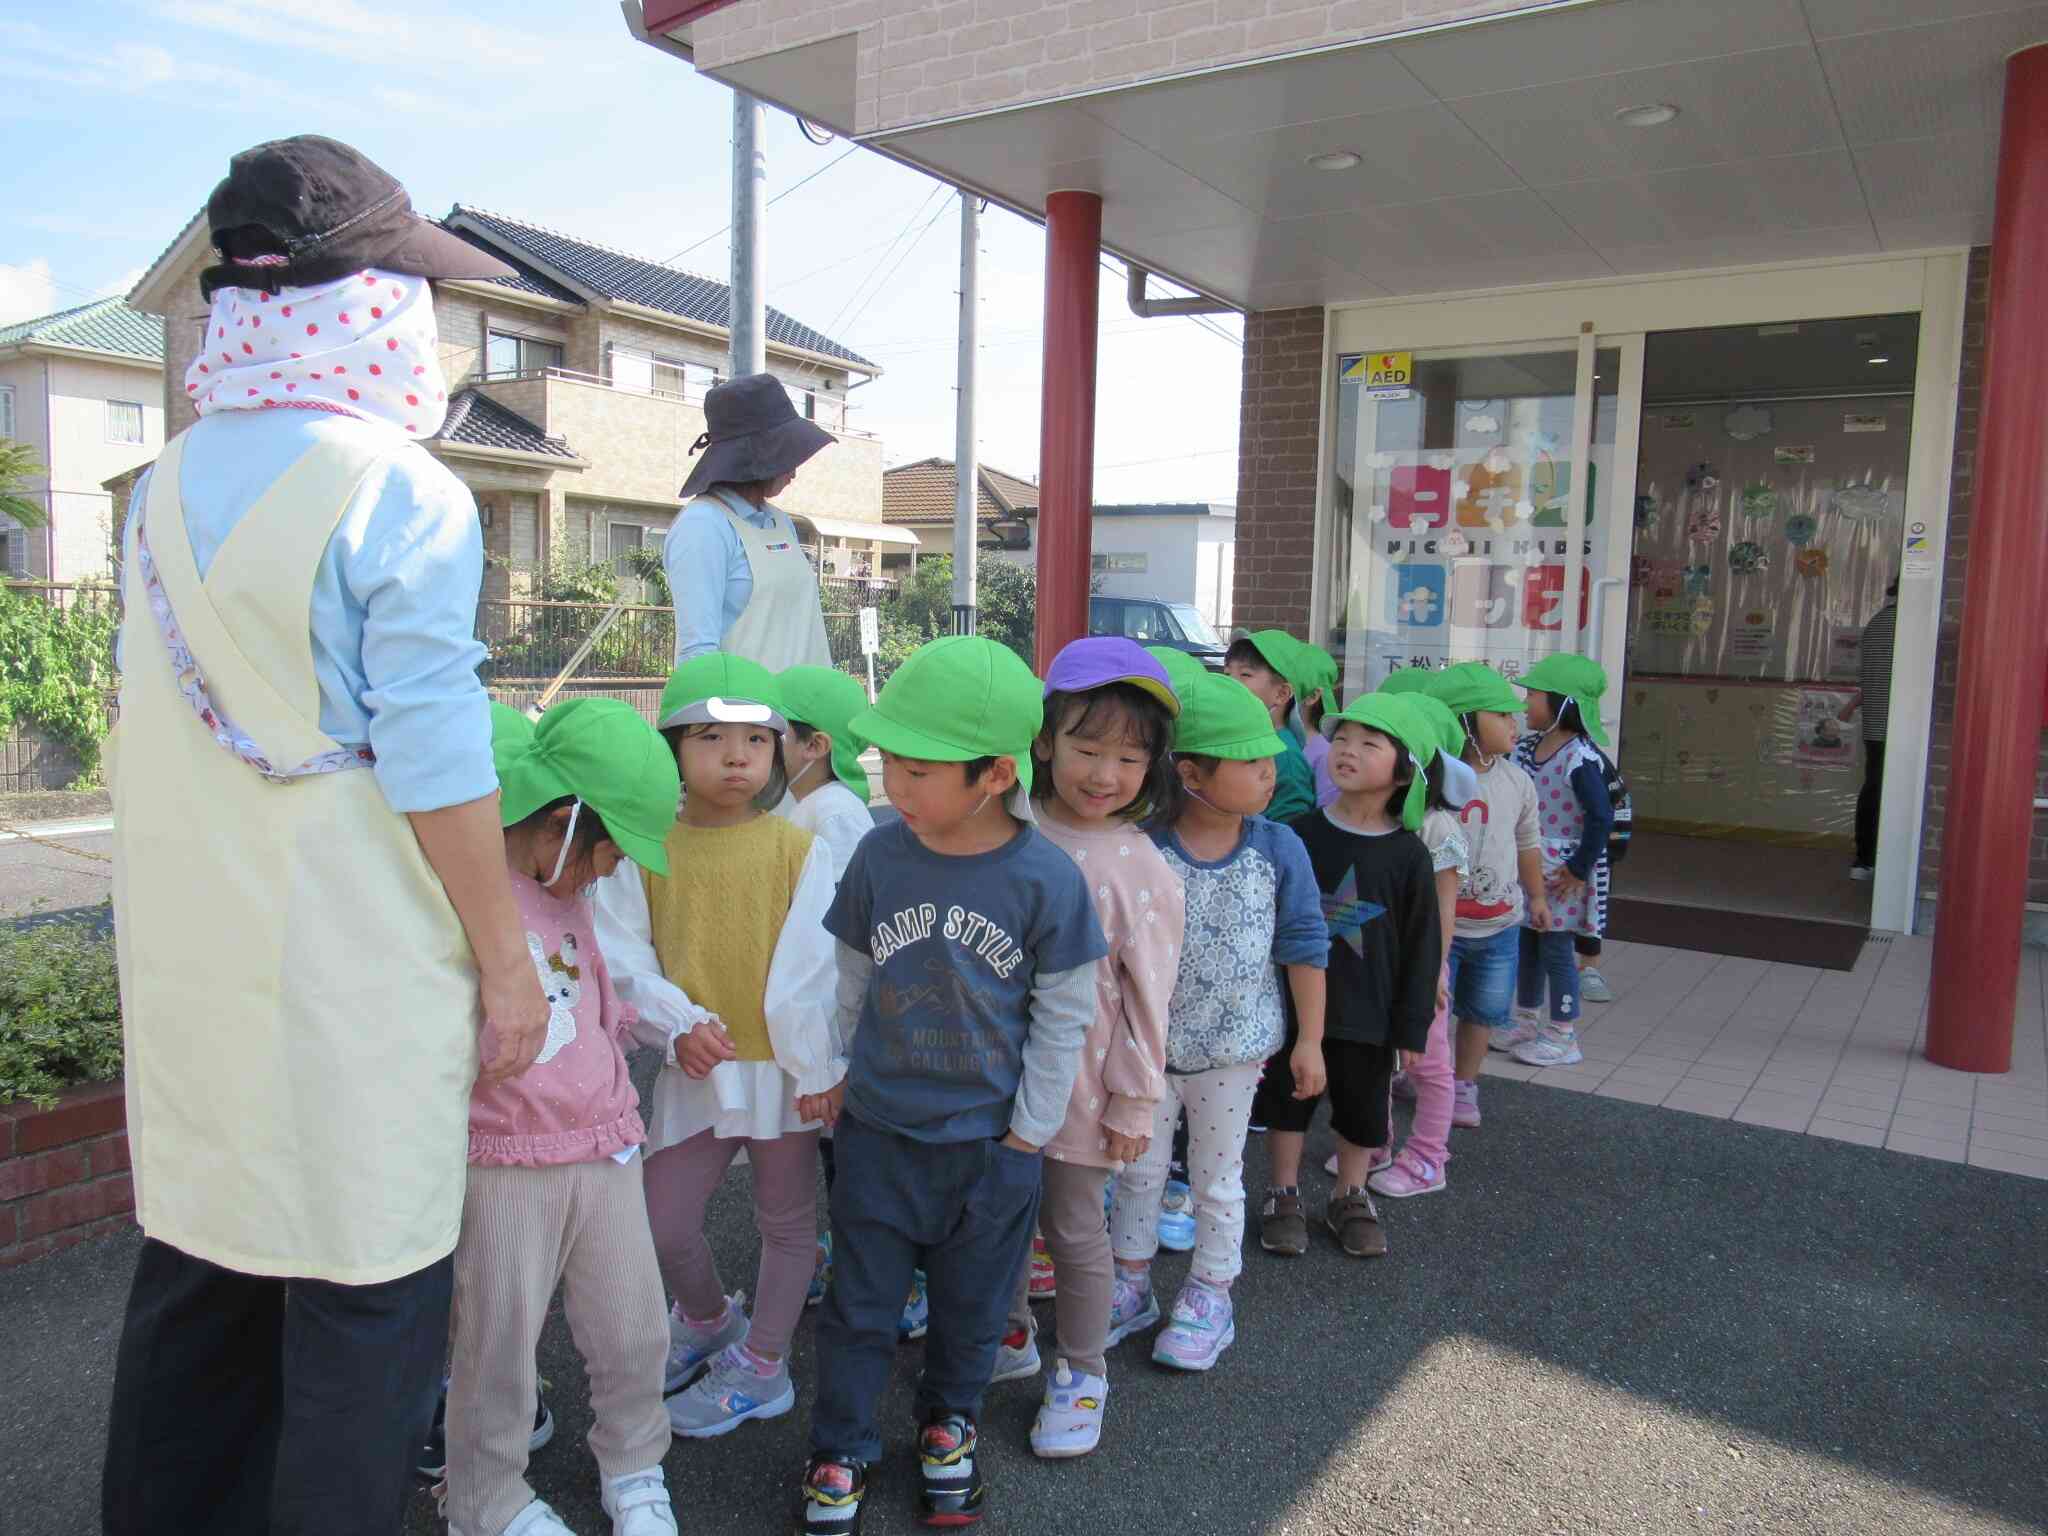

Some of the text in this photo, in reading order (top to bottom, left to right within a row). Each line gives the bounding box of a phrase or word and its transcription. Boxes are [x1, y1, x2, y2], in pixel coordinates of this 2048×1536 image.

[1371, 369, 1406, 384] AED
[1387, 540, 1491, 555] NICII
[871, 902, 1023, 979] CAMP STYLE
